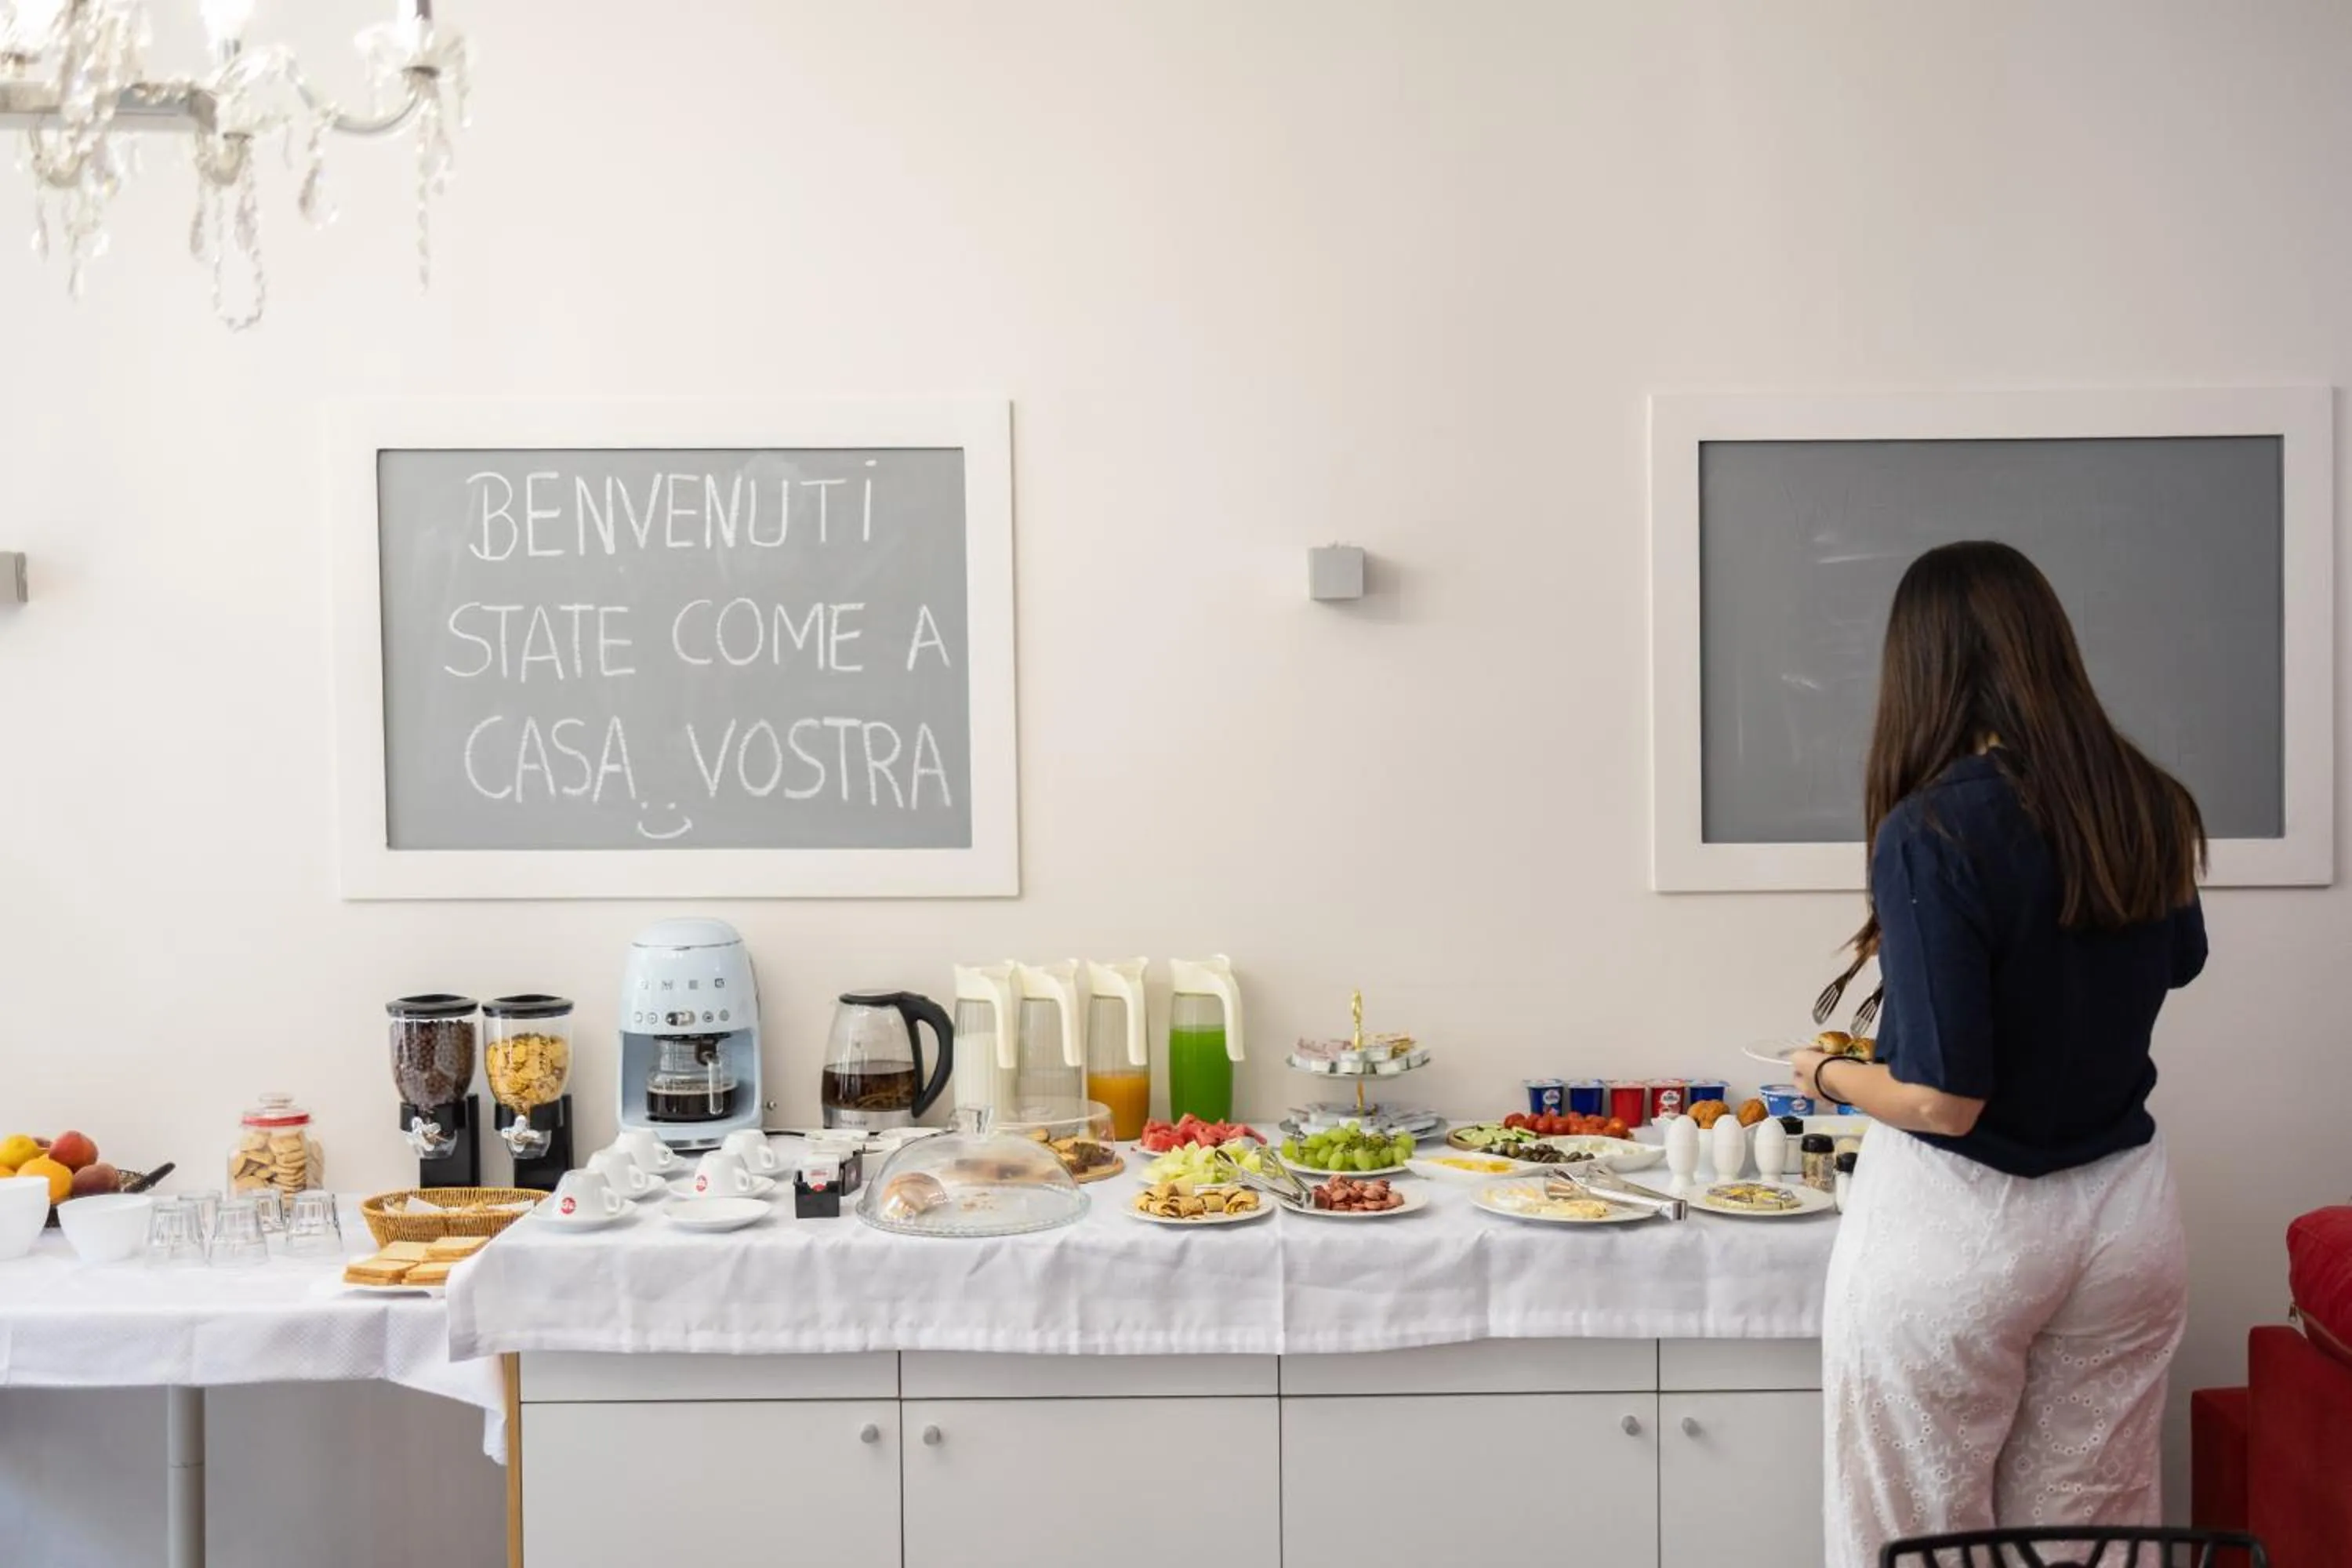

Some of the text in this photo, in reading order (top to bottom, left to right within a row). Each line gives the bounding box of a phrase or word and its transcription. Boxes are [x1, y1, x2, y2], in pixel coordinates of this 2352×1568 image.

[444, 597, 951, 683] STATE COME A
[463, 715, 953, 810] CASA VOSTRA
